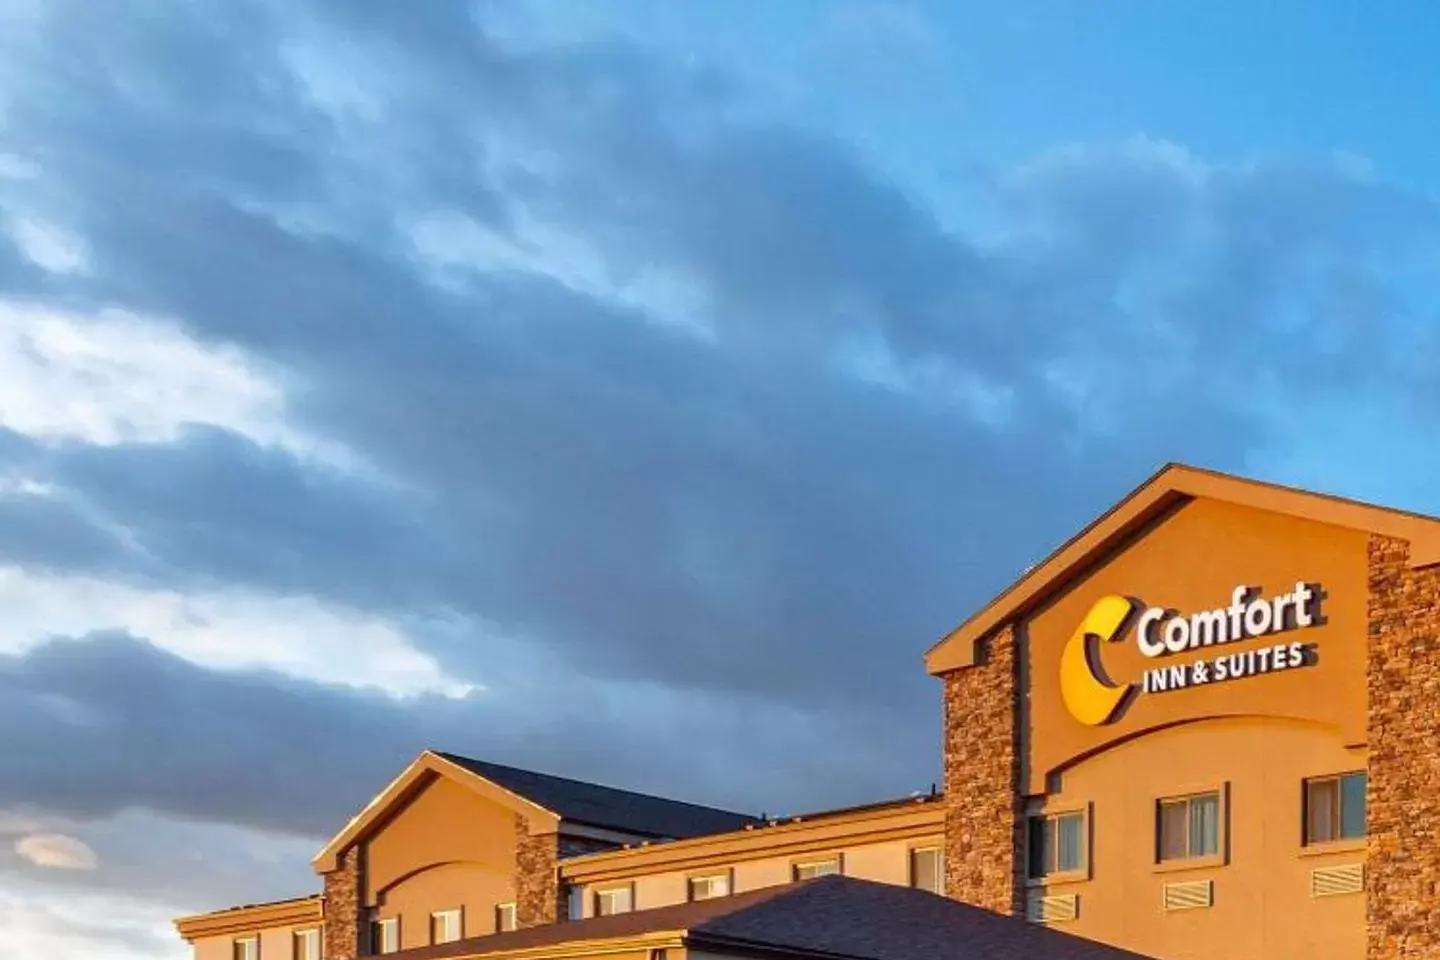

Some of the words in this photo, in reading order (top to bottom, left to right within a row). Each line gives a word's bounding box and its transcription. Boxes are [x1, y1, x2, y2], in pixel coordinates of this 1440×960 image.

[1136, 581, 1312, 657] Comfort
[1143, 664, 1186, 693] INN
[1191, 660, 1209, 685] &
[1213, 641, 1303, 681] SUITES
